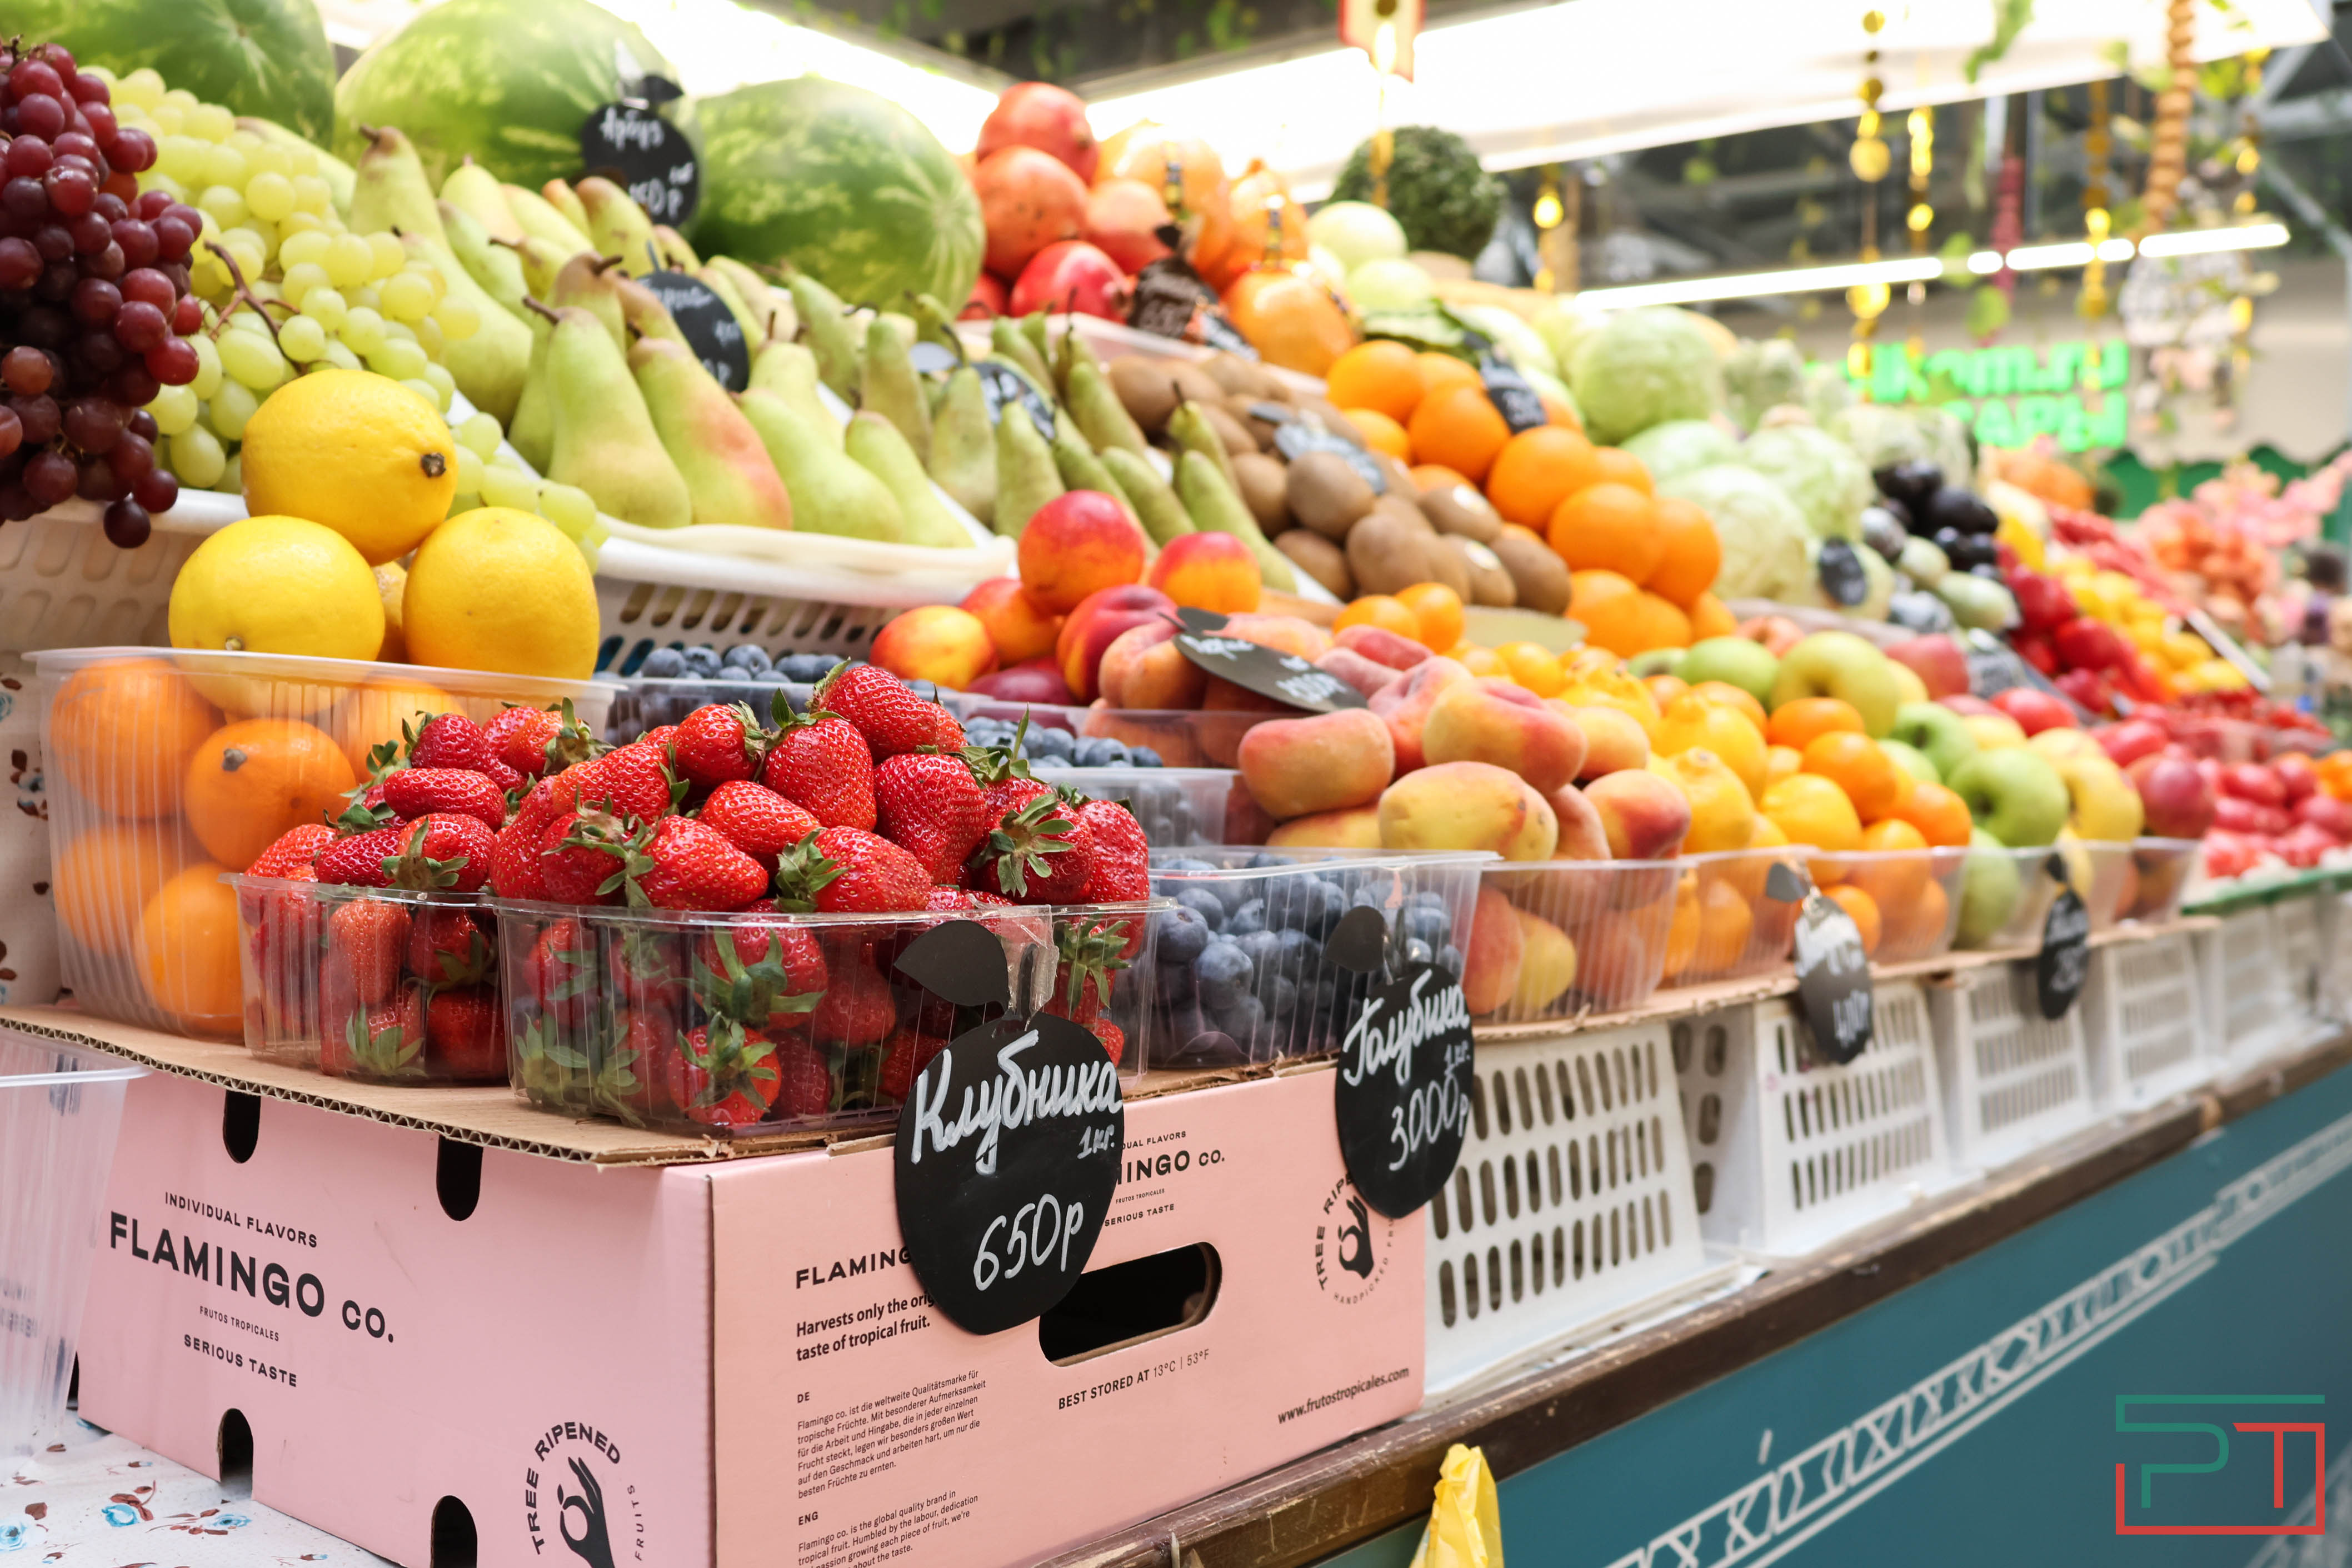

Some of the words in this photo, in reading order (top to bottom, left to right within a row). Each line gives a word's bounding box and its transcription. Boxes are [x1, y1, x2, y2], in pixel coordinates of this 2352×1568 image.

[1342, 968, 1470, 1086] Голубика
[911, 1029, 1123, 1175] Клубника
[1147, 1131, 1186, 1146] FLAVORS
[1199, 1150, 1225, 1166] CO.
[165, 1191, 241, 1227] INDIVIDUAL
[247, 1217, 317, 1248] FLAVORS
[1105, 1211, 1143, 1227] SERIOUS
[1147, 1204, 1175, 1216] TASTE
[1116, 1195, 1135, 1205] FRUTOS
[1136, 1189, 1165, 1199] TROPICALES
[796, 1246, 912, 1289] FLAMING
[973, 1194, 1084, 1291] 650р
[1315, 1226, 1327, 1291] TREE
[111, 1210, 325, 1317] FLAMINGO
[342, 1300, 394, 1343] CO.
[199, 1305, 228, 1324] FRUTOS
[231, 1317, 279, 1342] TROPICALES
[796, 1313, 853, 1337] Harvests
[857, 1303, 884, 1322] only
[887, 1298, 907, 1314] the
[911, 1291, 935, 1307] orig
[796, 1344, 829, 1361] taste
[833, 1335, 846, 1351] of
[849, 1322, 897, 1348] tropical
[900, 1315, 930, 1335] fruit.
[184, 1334, 243, 1367] SERIOUS
[249, 1359, 297, 1388] TASTE
[1058, 1390, 1087, 1410] BEST
[1090, 1375, 1133, 1399] STORED
[1137, 1369, 1150, 1384] AT
[797, 1391, 810, 1404] DE
[797, 1414, 833, 1431] Flamingo
[835, 1410, 847, 1419] co.
[849, 1405, 859, 1415] ist
[861, 1401, 872, 1412] die
[874, 1391, 910, 1407] weltweite
[912, 1374, 966, 1397] Qualitätsmarke
[968, 1370, 978, 1380] für
[797, 1427, 835, 1444] tropische
[837, 1417, 868, 1432] Früchte.
[871, 1411, 883, 1422] Mit
[885, 1399, 927, 1417] besonderer
[928, 1380, 986, 1405] Aufmerksamkeit
[1277, 1367, 1409, 1424] www.frutostropicales.com
[797, 1447, 809, 1458] für
[811, 1443, 823, 1454] die
[825, 1435, 849, 1449] Arbeit
[851, 1429, 866, 1441] und
[868, 1420, 901, 1436] Hingabe,
[902, 1415, 914, 1425] die
[916, 1412, 922, 1421] in
[924, 1406, 943, 1421] jeder
[944, 1396, 977, 1412] einzelnen
[797, 1472, 811, 1485] auf
[812, 1470, 827, 1480] den
[829, 1452, 874, 1475] Geschmack
[876, 1447, 890, 1460] und
[892, 1439, 922, 1454] arbeiten
[925, 1432, 941, 1444] hart,
[943, 1429, 954, 1437] um
[956, 1424, 967, 1434] nur
[969, 1419, 980, 1429] die
[798, 1456, 823, 1471] Frucht
[826, 1447, 852, 1462] steckt,
[855, 1441, 875, 1454] legen
[877, 1435, 888, 1446] wir
[890, 1424, 928, 1442] besonders
[930, 1416, 955, 1431] großen
[957, 1409, 973, 1420] Wert
[525, 1467, 545, 1555] TREE
[535, 1422, 620, 1464] RIPENED
[798, 1484, 825, 1499] besten
[827, 1473, 857, 1489] Früchte
[858, 1470, 867, 1479] zu
[869, 1461, 896, 1475] ernten.
[627, 1485, 644, 1561] FRUITS
[798, 1511, 818, 1526] ENG
[798, 1534, 834, 1552] Flamingo
[836, 1530, 848, 1539] co.
[850, 1525, 857, 1534] is
[859, 1520, 872, 1530] the
[873, 1509, 897, 1527] global
[898, 1502, 924, 1517] quality
[926, 1491, 947, 1506] brand
[798, 1546, 828, 1566] tropical
[831, 1540, 850, 1554] fruit.
[852, 1525, 886, 1546] Humbled
[889, 1524, 898, 1534] by
[899, 1519, 912, 1529] the
[913, 1510, 938, 1524] labour,
[940, 1495, 977, 1514] dedication
[847, 1542, 878, 1562] growing
[880, 1535, 898, 1549] each
[900, 1529, 920, 1543] piece
[922, 1522, 930, 1533] of
[931, 1517, 949, 1529] fruit,
[951, 1510, 970, 1522] we're
[877, 1552, 889, 1562] the
[891, 1545, 912, 1557] taste.
